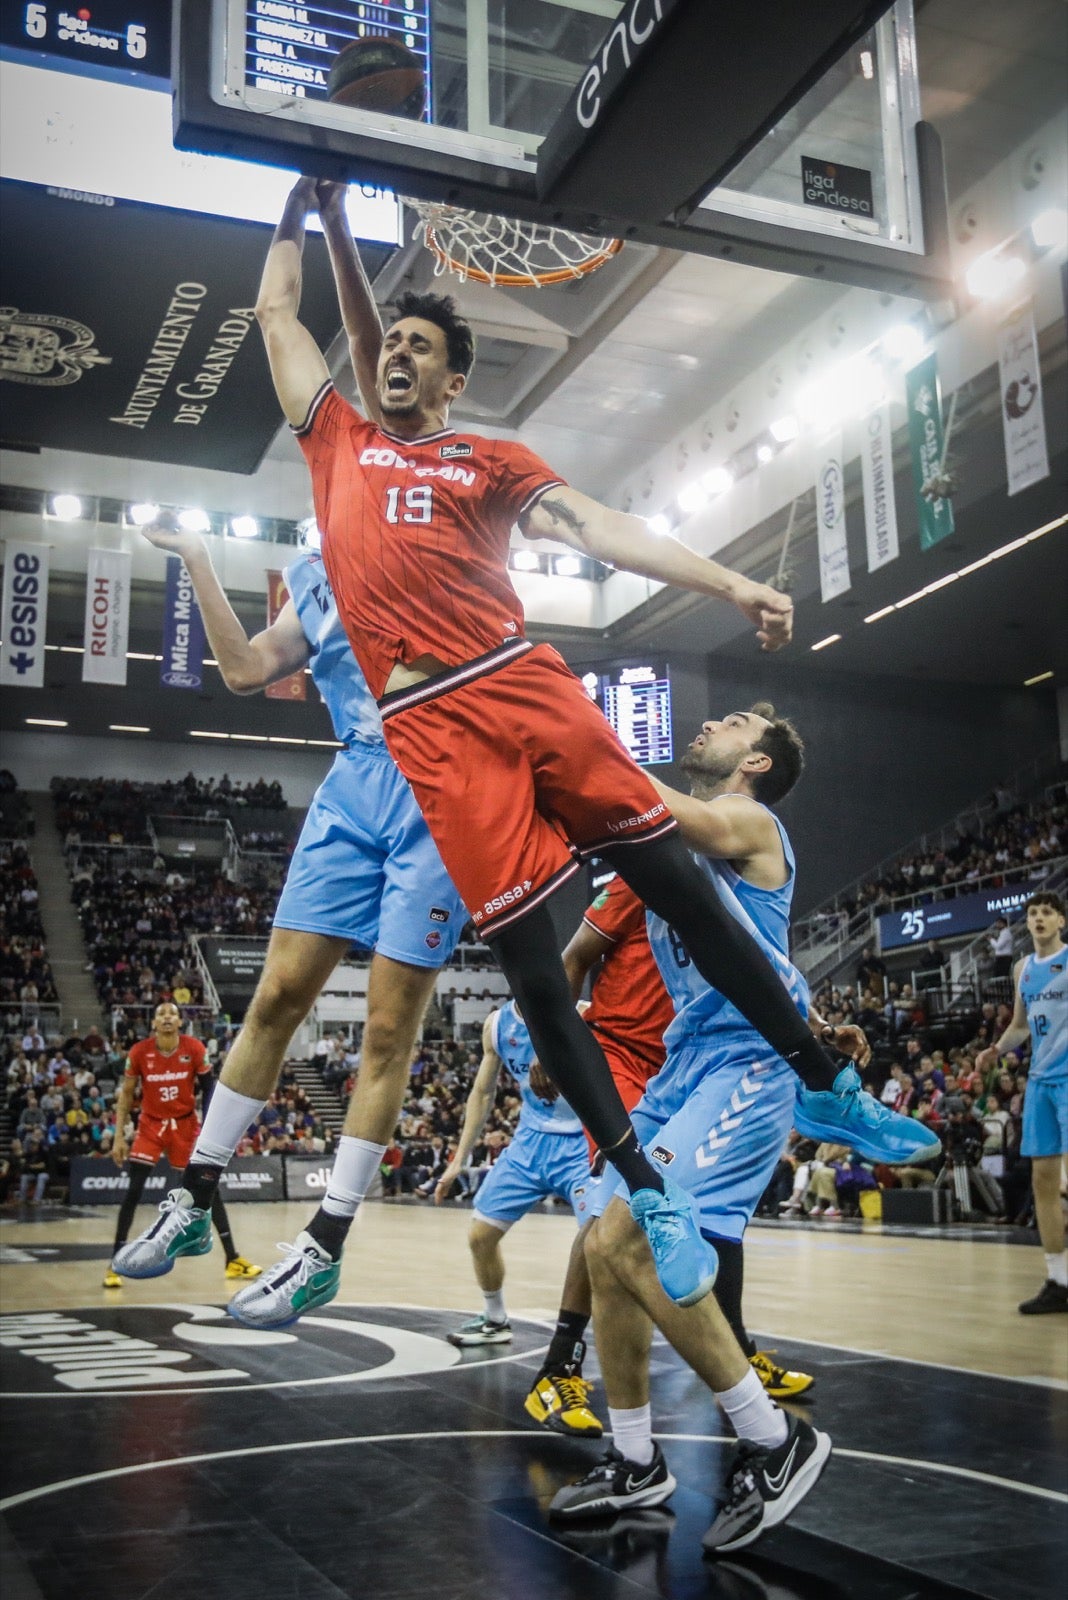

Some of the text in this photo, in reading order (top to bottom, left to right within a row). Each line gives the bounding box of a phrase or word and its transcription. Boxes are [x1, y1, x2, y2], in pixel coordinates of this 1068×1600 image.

[26, 3, 47, 38] 5
[58, 28, 119, 50] endesa
[126, 24, 147, 59] 5
[804, 170, 835, 190] liga
[58, 188, 115, 207] MONDO
[805, 188, 871, 213] endesa
[109, 281, 208, 429] AYUNTAMIENTO
[176, 308, 256, 400] GRANADA
[386, 484, 434, 524] 19
[10, 553, 40, 648] asisa
[91, 578, 110, 657] RICOH
[171, 624, 189, 672] Mica
[619, 803, 666, 829] BERNER
[484, 884, 524, 914] asisa
[431, 912, 445, 920] acb
[901, 909, 925, 940] 25
[216, 948, 267, 957] AYUNTAMIENT
[1034, 1014, 1048, 1036] 12
[159, 1086, 179, 1102] 32
[653, 1150, 667, 1161] acb
[0, 1313, 251, 1390] PULEVA
